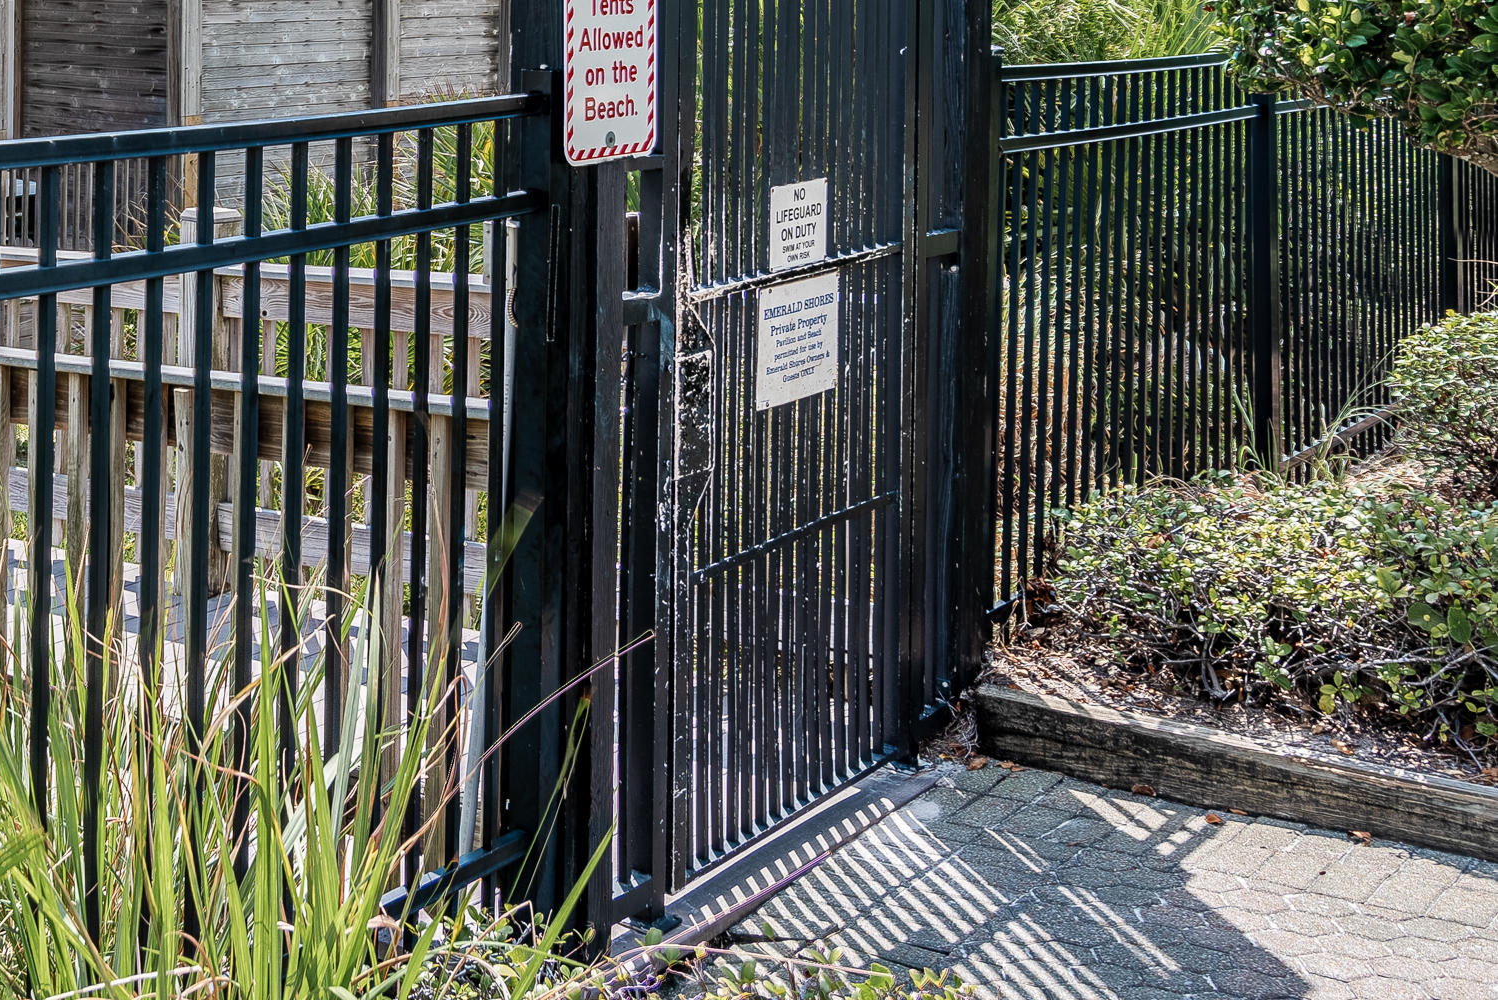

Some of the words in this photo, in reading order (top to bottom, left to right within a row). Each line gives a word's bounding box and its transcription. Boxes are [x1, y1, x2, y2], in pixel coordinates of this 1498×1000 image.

[578, 25, 644, 52] Allowed
[585, 67, 605, 87] on
[611, 60, 638, 84] the
[584, 94, 639, 122] Beach.
[793, 187, 806, 202] NO
[776, 202, 822, 224] LIFEGUARD
[781, 226, 793, 242] ON
[795, 222, 817, 239] DUTY
[782, 244, 795, 254] SWIM
[795, 242, 802, 250] AT
[802, 239, 815, 249] YOUR
[787, 253, 799, 263] OWN
[799, 251, 810, 260] RISK
[764, 301, 803, 320] EMERALD
[804, 292, 834, 310] SHORES
[770, 321, 796, 336] Private
[797, 313, 828, 330] Property
[797, 332, 807, 342] and
[807, 328, 822, 339] Beach
[766, 362, 788, 375] Emerald
[789, 358, 806, 369] Shores
[806, 353, 825, 363] Owners
[826, 349, 831, 358] &
[774, 348, 798, 362] permitted
[799, 345, 807, 353] for
[808, 343, 817, 351] use
[817, 340, 823, 350] by
